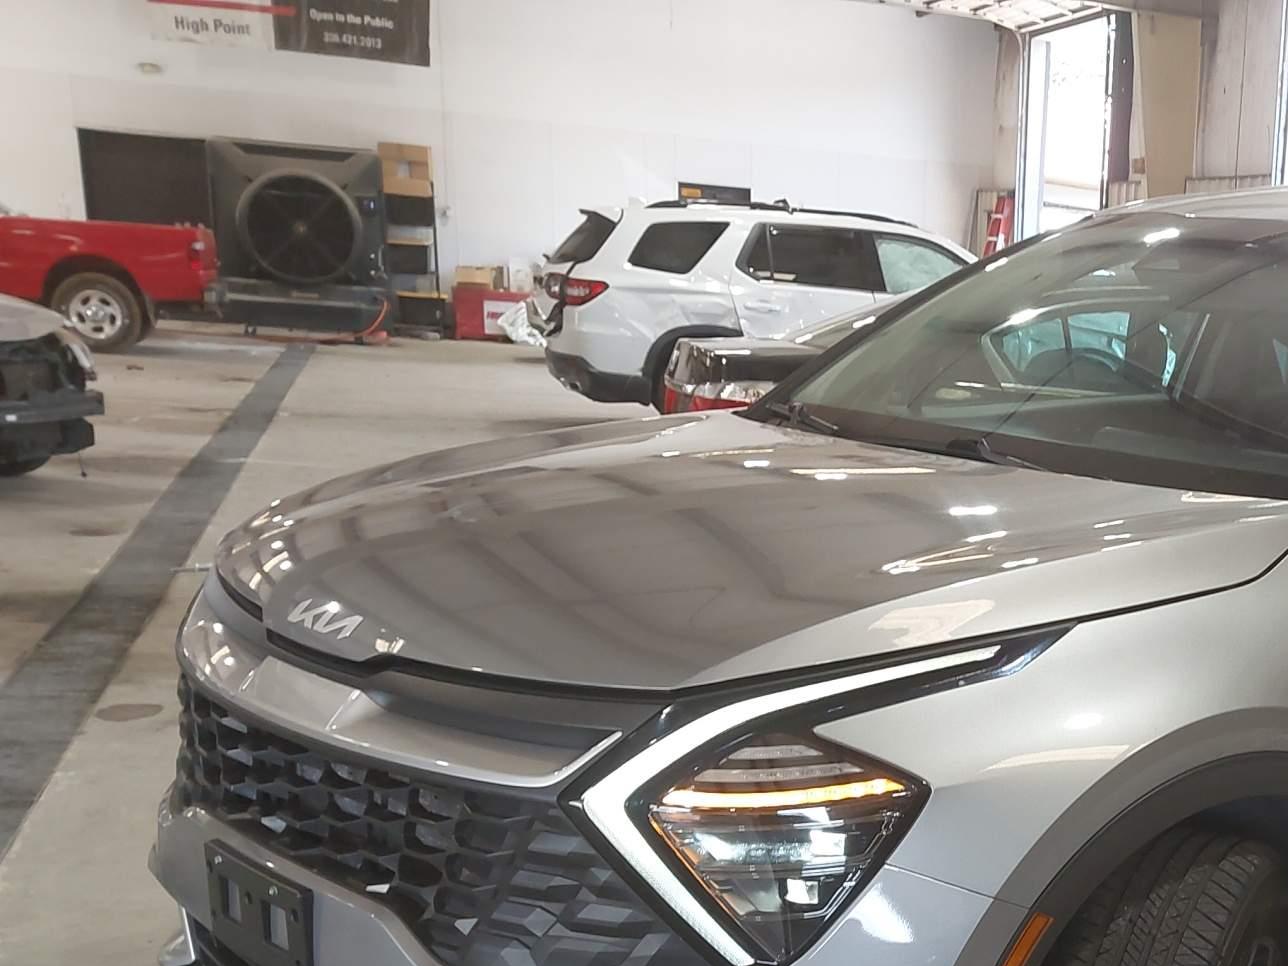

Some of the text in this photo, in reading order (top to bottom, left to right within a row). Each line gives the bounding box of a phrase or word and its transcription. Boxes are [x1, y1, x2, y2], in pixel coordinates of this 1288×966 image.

[174, 15, 251, 36] High Point
[309, 8, 394, 30] Open to the Public
[287, 598, 364, 640] KIA
